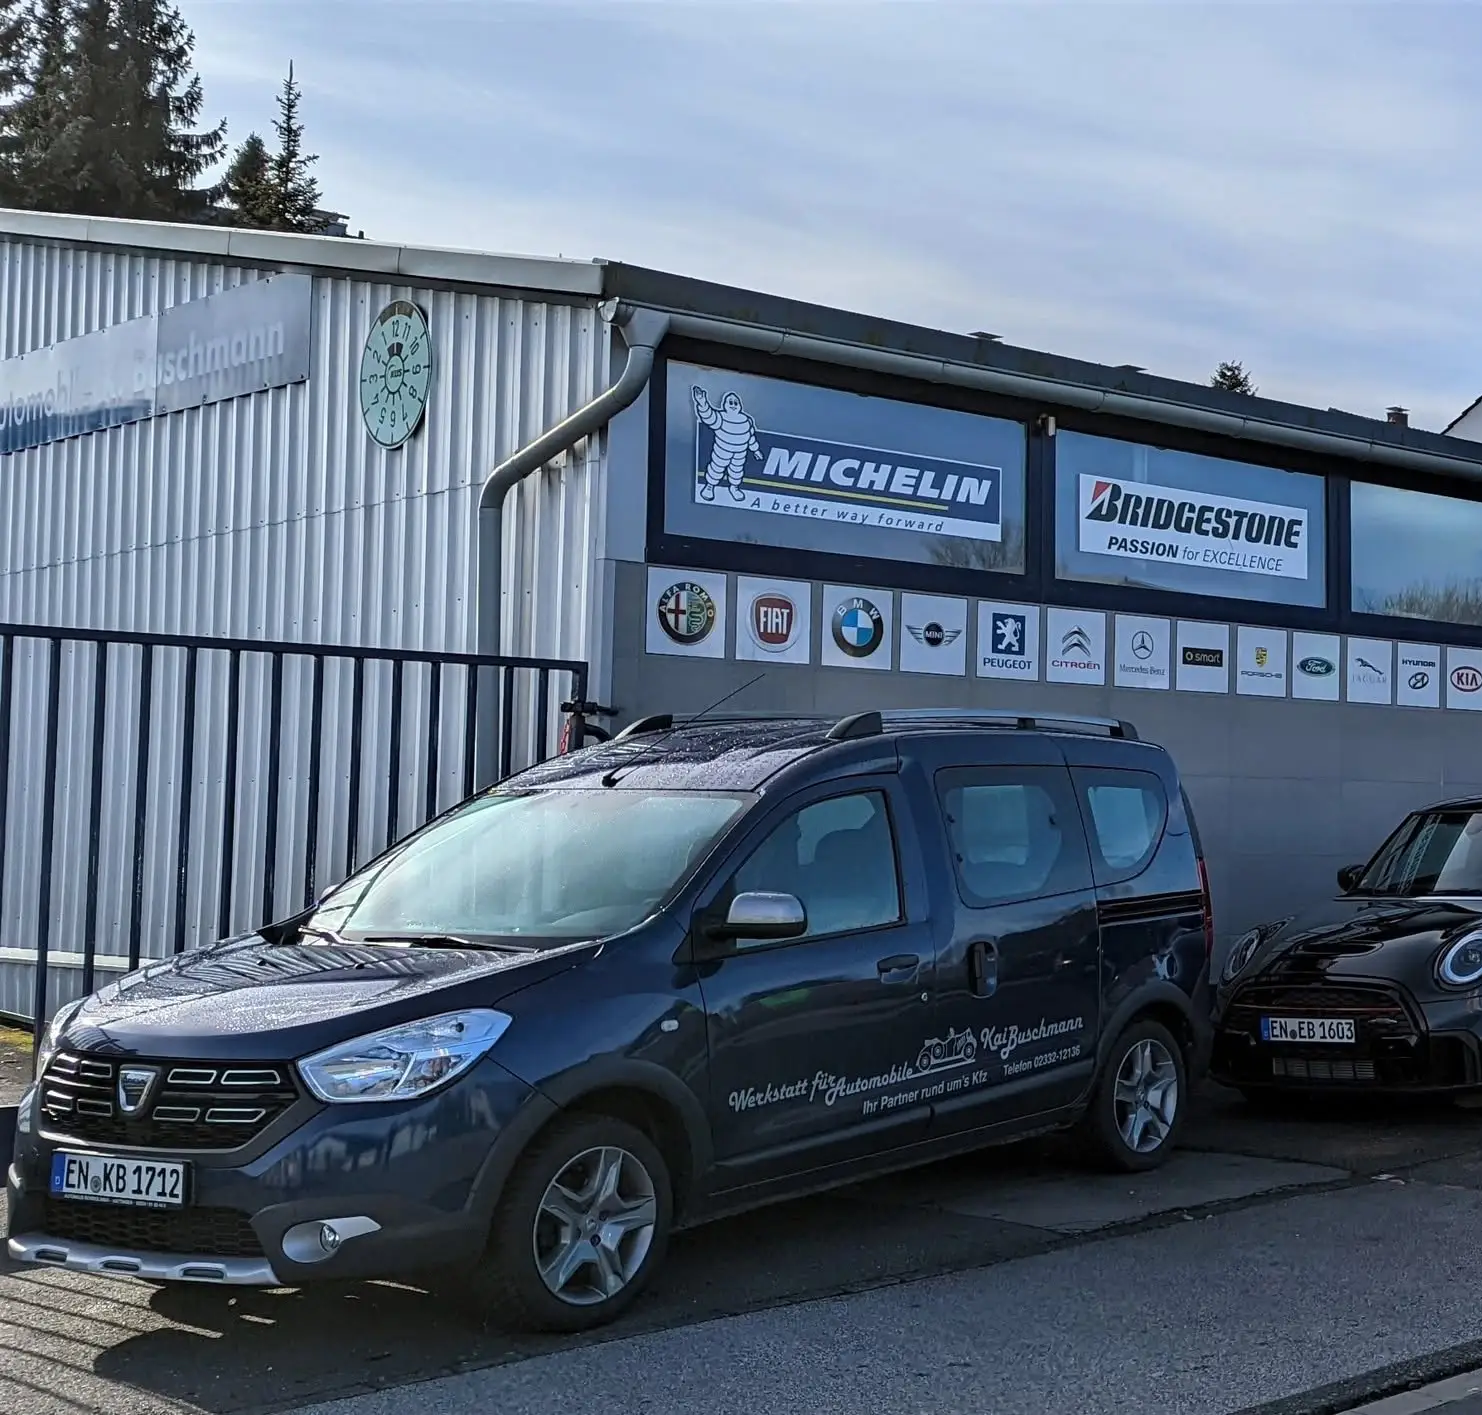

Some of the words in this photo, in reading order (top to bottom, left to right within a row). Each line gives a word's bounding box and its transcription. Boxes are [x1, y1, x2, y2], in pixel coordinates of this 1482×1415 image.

[392, 319, 400, 337] 12
[402, 322, 411, 342] 11
[410, 336, 420, 356] 10
[373, 350, 382, 364] 2
[369, 373, 378, 384] 3
[371, 393, 380, 405] 4
[408, 385, 418, 399] 8
[379, 407, 387, 424] 5
[390, 410, 396, 427] 6
[762, 447, 993, 505] MICHELIN
[750, 498, 762, 510] A
[771, 498, 828, 518] better
[836, 509, 869, 525] way
[877, 513, 945, 532] forward
[1085, 480, 1303, 549] BRIDGESTONE
[1107, 535, 1179, 558] PASSION
[1182, 546, 1201, 561] for
[1202, 549, 1284, 572] EXCELLENCE
[659, 585, 680, 613] ALFA
[685, 583, 714, 618] ROMEO
[837, 599, 881, 621] BMW
[759, 606, 790, 635] FIAT
[925, 630, 943, 639] MINI
[983, 657, 1032, 670] PEUGEOT
[1195, 653, 1220, 664] smart
[1306, 660, 1327, 673] Ford
[1402, 658, 1436, 667] HYUNDAI
[1240, 671, 1282, 679] PORSCHE
[1457, 672, 1479, 686] KIA
[1271, 1020, 1288, 1039] EN
[1298, 1021, 1316, 1039] EB
[1319, 1021, 1354, 1040] 1603
[1003, 1060, 1032, 1078] Telefon
[1034, 1045, 1081, 1069] 02332-12136
[729, 1079, 807, 1112] Werkstatt
[810, 1071, 836, 1102] für
[825, 1061, 914, 1107] Automobile
[863, 1099, 878, 1115] Ihr
[881, 1090, 919, 1111] Partner
[921, 1082, 945, 1101] rund
[947, 1076, 969, 1093] um's
[971, 1070, 988, 1085] Kfz
[65, 1159, 89, 1190] EN
[103, 1163, 127, 1193] KB
[132, 1165, 181, 1199] 1712
